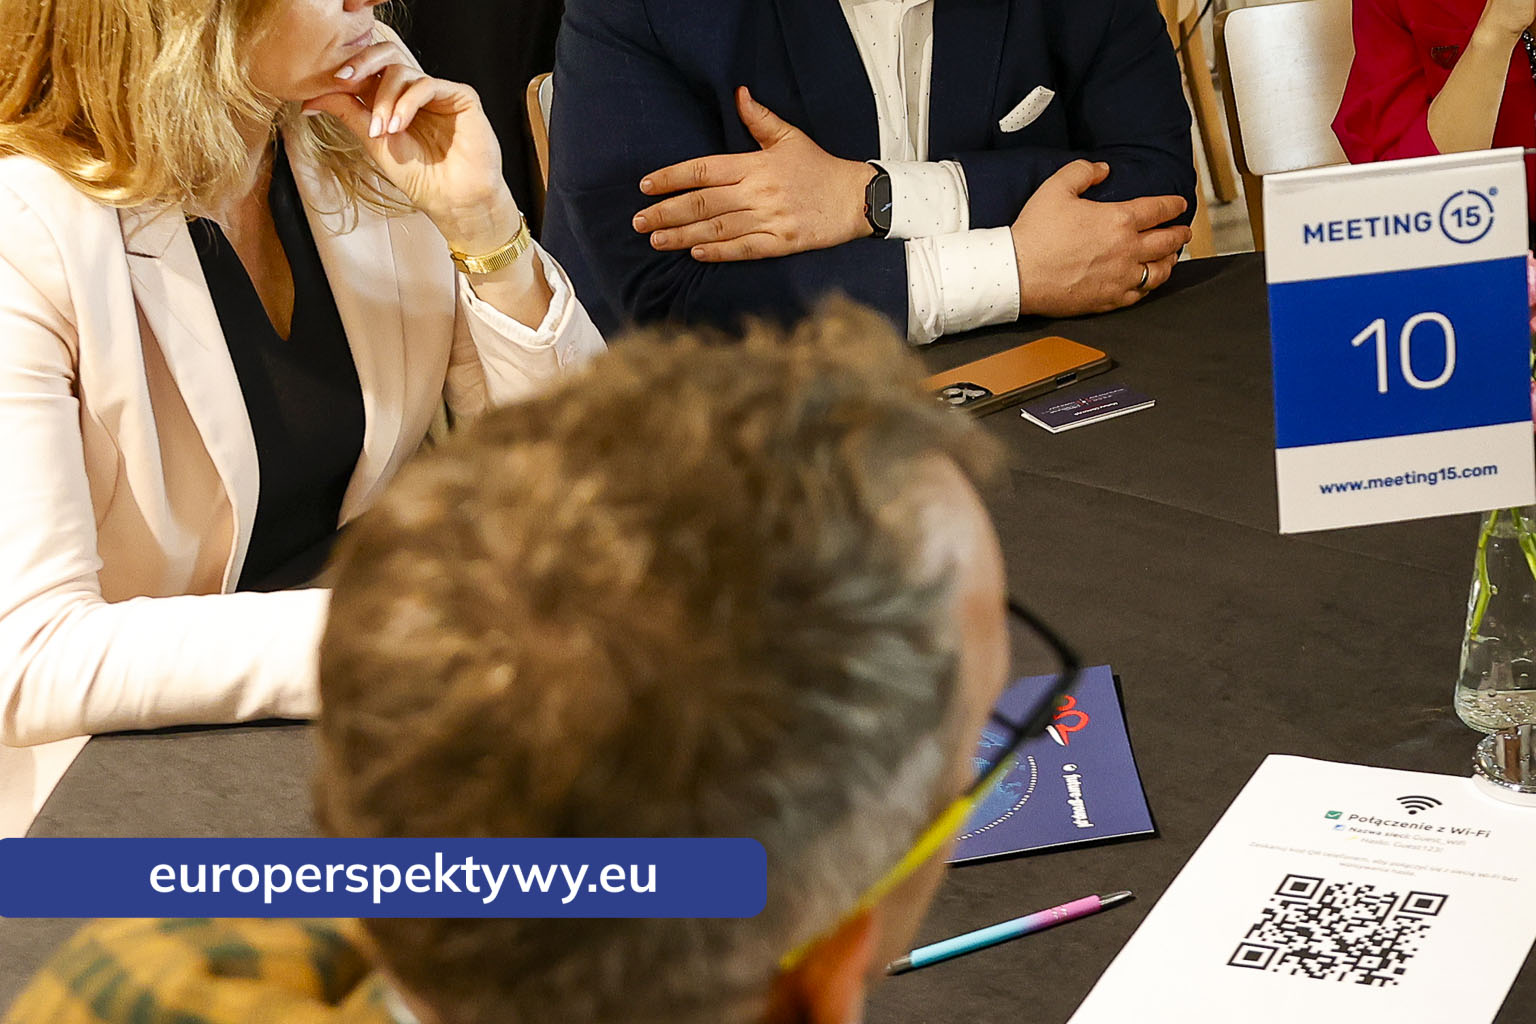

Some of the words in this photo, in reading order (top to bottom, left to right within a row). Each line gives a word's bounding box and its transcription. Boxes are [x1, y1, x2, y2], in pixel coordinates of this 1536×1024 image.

[1303, 211, 1432, 245] MEETING
[1451, 206, 1481, 228] 15
[1351, 311, 1457, 395] 10
[1319, 464, 1499, 495] www.meeting15.com
[1348, 813, 1433, 832] Połączenie
[1437, 825, 1446, 833] z
[1450, 826, 1492, 838] Wi-Fi
